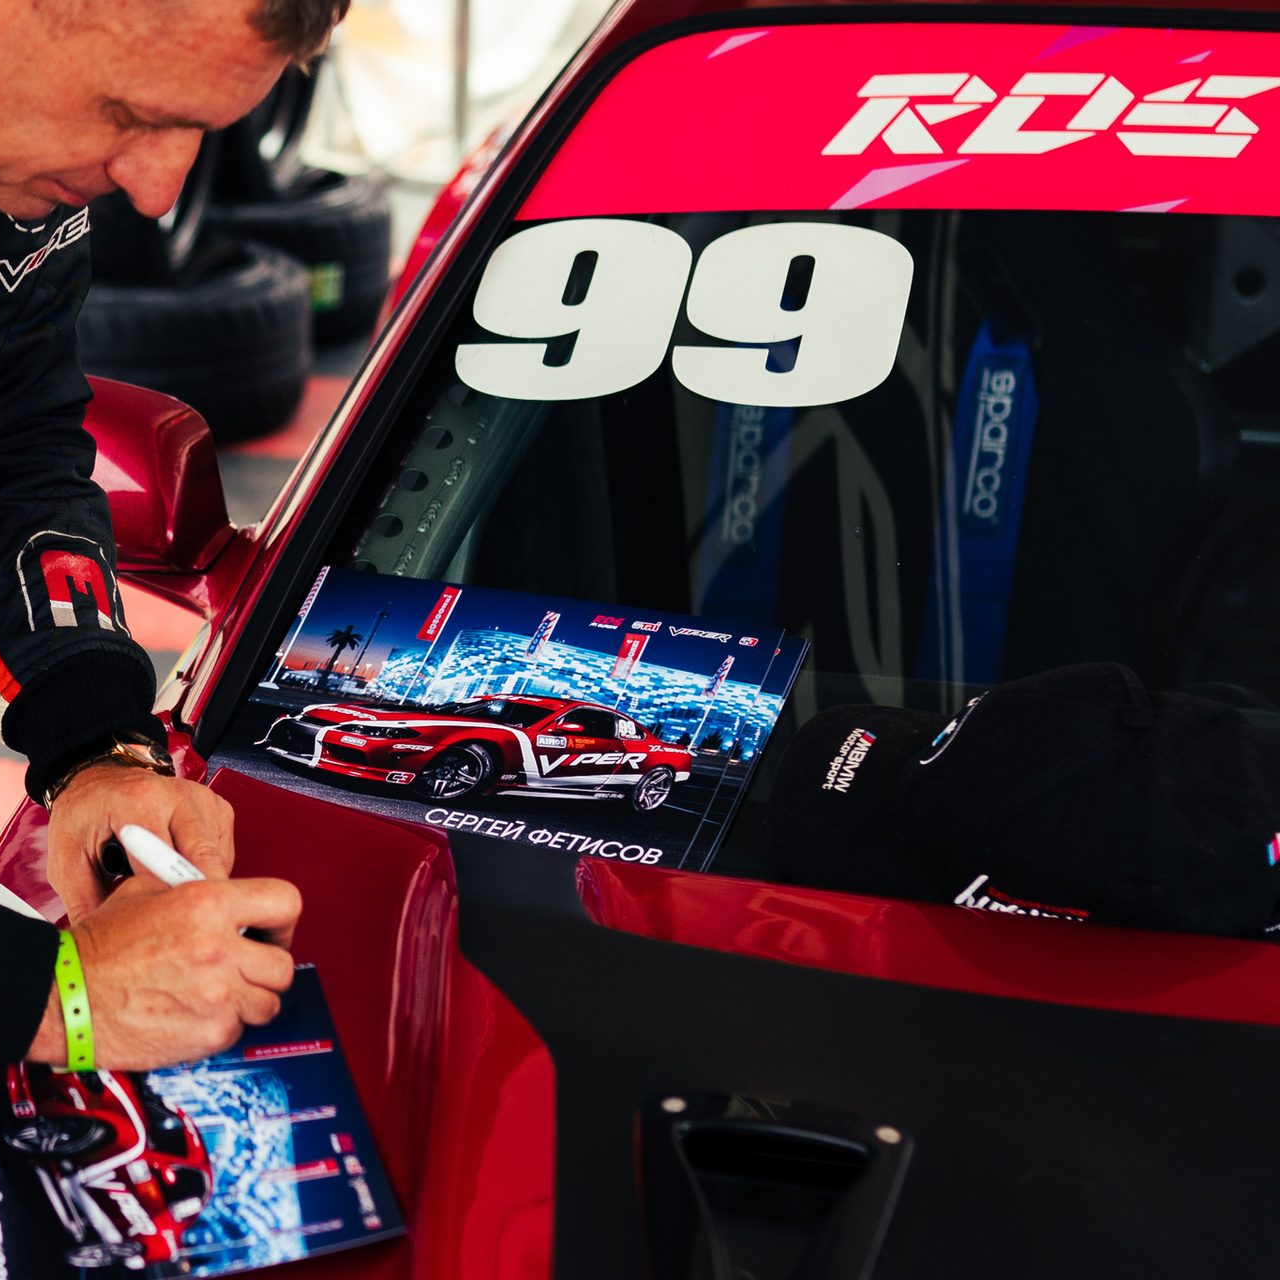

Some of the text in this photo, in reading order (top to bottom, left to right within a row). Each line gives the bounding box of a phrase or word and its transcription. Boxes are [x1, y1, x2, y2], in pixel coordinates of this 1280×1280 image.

[821, 72, 1280, 158] RDS
[455, 218, 915, 407] 99
[960, 368, 1016, 520] sparco
[592, 614, 626, 628] RDS
[669, 626, 733, 643] VIPER
[619, 720, 636, 736] 99
[539, 752, 648, 775] VIPER
[822, 728, 866, 791] Motorsport
[424, 808, 663, 865] СЕРГЕЙ ФЕТИСОВ
